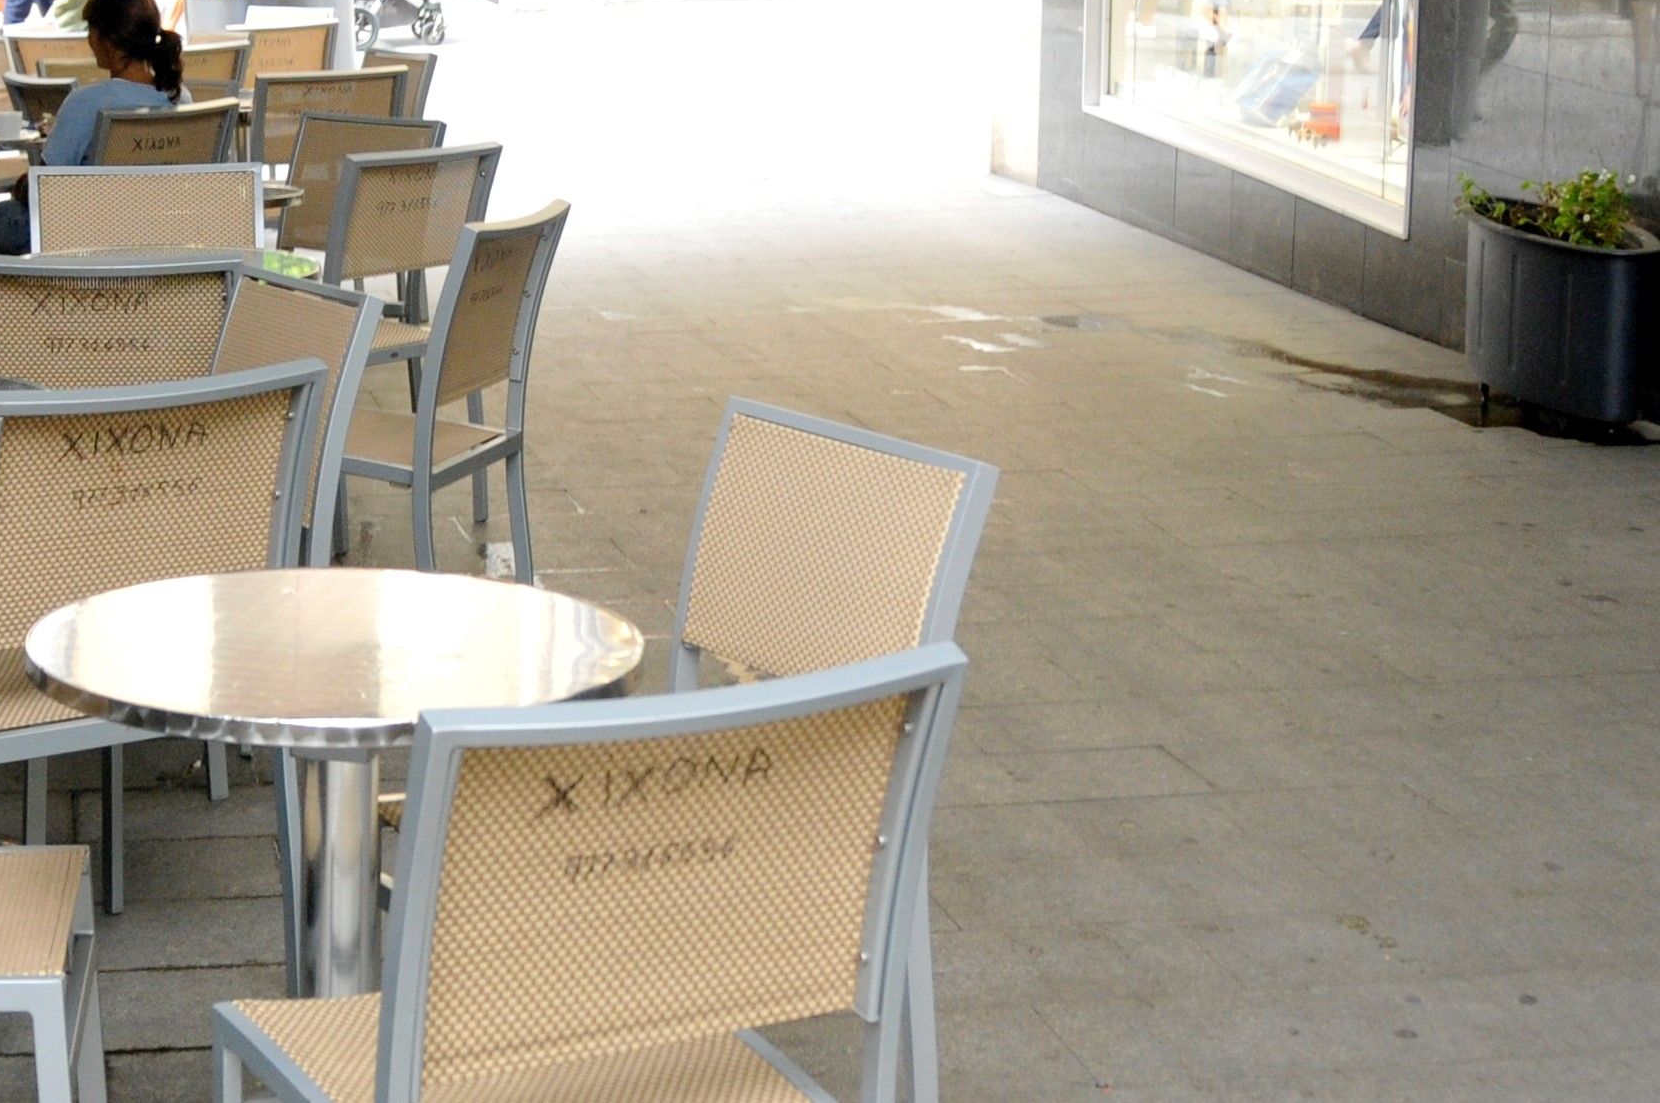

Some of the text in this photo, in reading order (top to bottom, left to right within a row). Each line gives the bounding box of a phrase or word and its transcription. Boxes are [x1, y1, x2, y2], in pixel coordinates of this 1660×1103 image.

[131, 136, 181, 152] XIXONA
[26, 290, 149, 318] XIXONA
[55, 420, 208, 465] XIXONA
[528, 744, 775, 824] XIXONA
